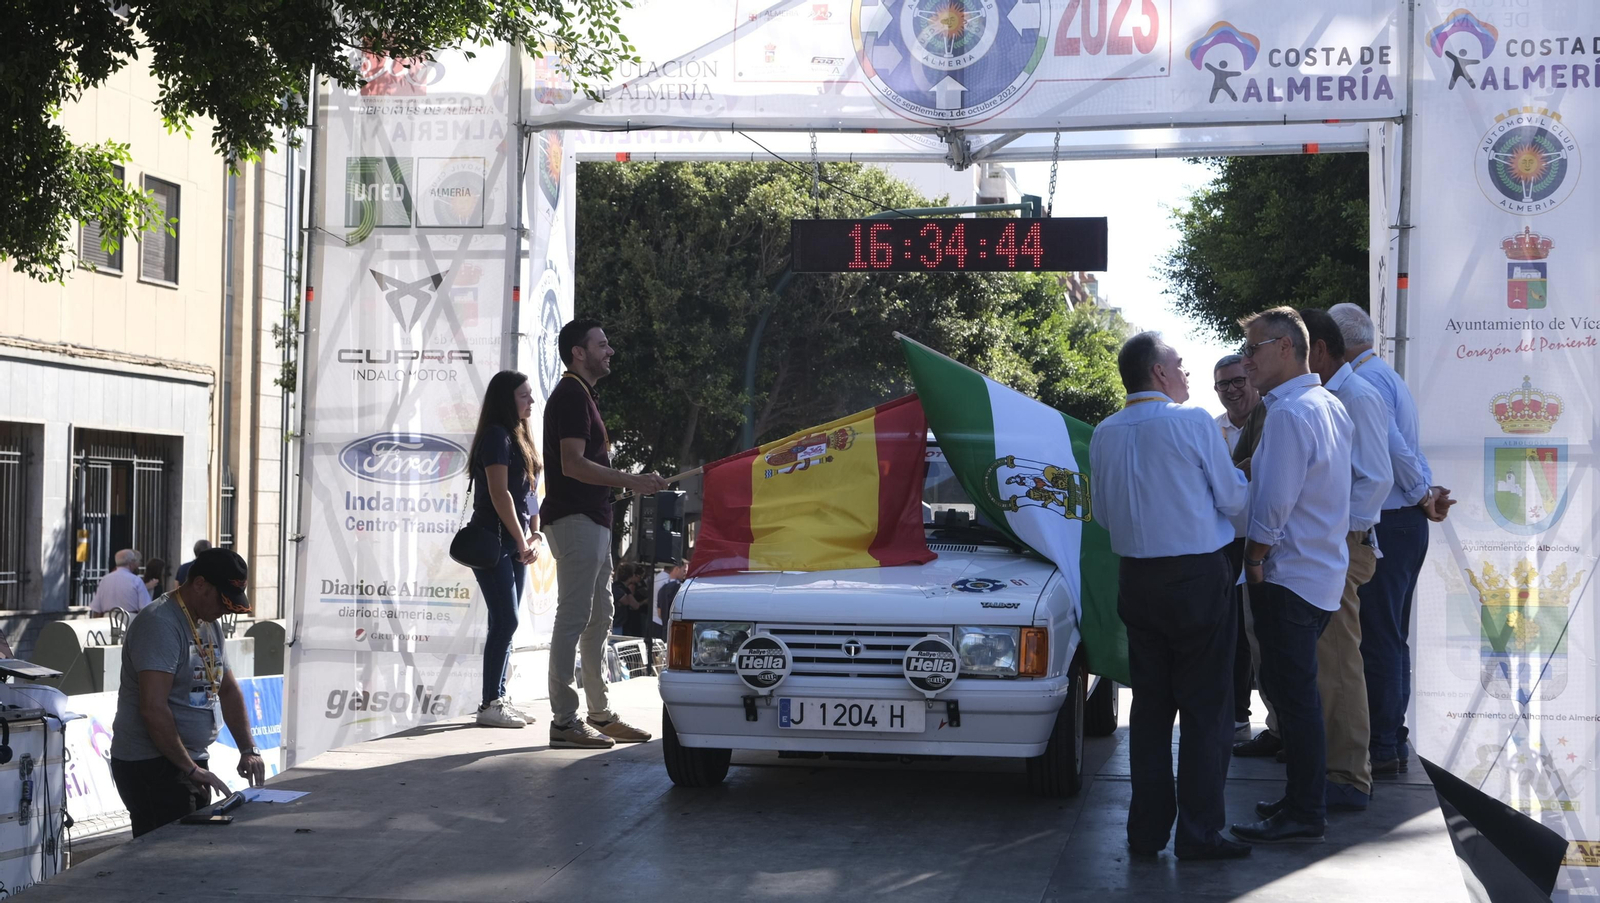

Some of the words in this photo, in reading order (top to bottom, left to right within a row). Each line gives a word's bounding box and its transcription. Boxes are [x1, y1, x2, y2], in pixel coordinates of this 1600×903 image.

[1505, 36, 1586, 58] COSTA
[922, 54, 975, 67] ALMERIA
[1268, 46, 1353, 68] COSTA
[1360, 45, 1392, 66] DE
[618, 79, 715, 100] ALMERÍA
[1242, 66, 1395, 104] ALMERÍA
[881, 85, 893, 97] 30
[891, 91, 902, 104] de
[955, 109, 967, 117] de
[967, 99, 998, 115] octubre
[997, 85, 1018, 102] 2023
[358, 105, 421, 116] DEPORTES
[423, 105, 440, 116] DE
[1482, 116, 1546, 153] AUTOMOVIL
[1551, 124, 1575, 152] CLUB
[429, 186, 472, 198] ALMERÍA
[1499, 198, 1557, 212] ALMERIA
[848, 222, 1045, 269] 16:34:44
[1444, 317, 1545, 334] Ayuntamiento
[1548, 317, 1566, 331] de
[337, 348, 474, 365] CUPRA
[1456, 342, 1512, 361] Corazón
[1514, 337, 1537, 353] del
[1539, 334, 1598, 353] Poniente
[362, 440, 443, 475] Ford
[345, 491, 459, 514] Indamóvil
[345, 515, 397, 532] Centro
[401, 517, 457, 534] Transit
[1462, 544, 1523, 553] Ayuntamiento
[1523, 544, 1536, 552] de
[1537, 544, 1581, 554] Alboloduy
[320, 578, 375, 597] Diario
[377, 580, 397, 597] de
[398, 581, 470, 600] Almería
[338, 606, 451, 621] diariodealmeria.es
[980, 601, 1021, 609] TALBOT
[741, 655, 784, 670] Hella
[909, 658, 954, 673] Hella
[324, 684, 453, 719] gasolia
[782, 715, 788, 723] E
[790, 702, 804, 726] J
[819, 702, 878, 728] 1204
[889, 704, 905, 729] H
[1446, 710, 1507, 719] Ayuntamiento
[1508, 711, 1519, 720] de
[1521, 711, 1554, 721] Alhama
[1556, 712, 1568, 721] de
[1550, 801, 1565, 811] DE
